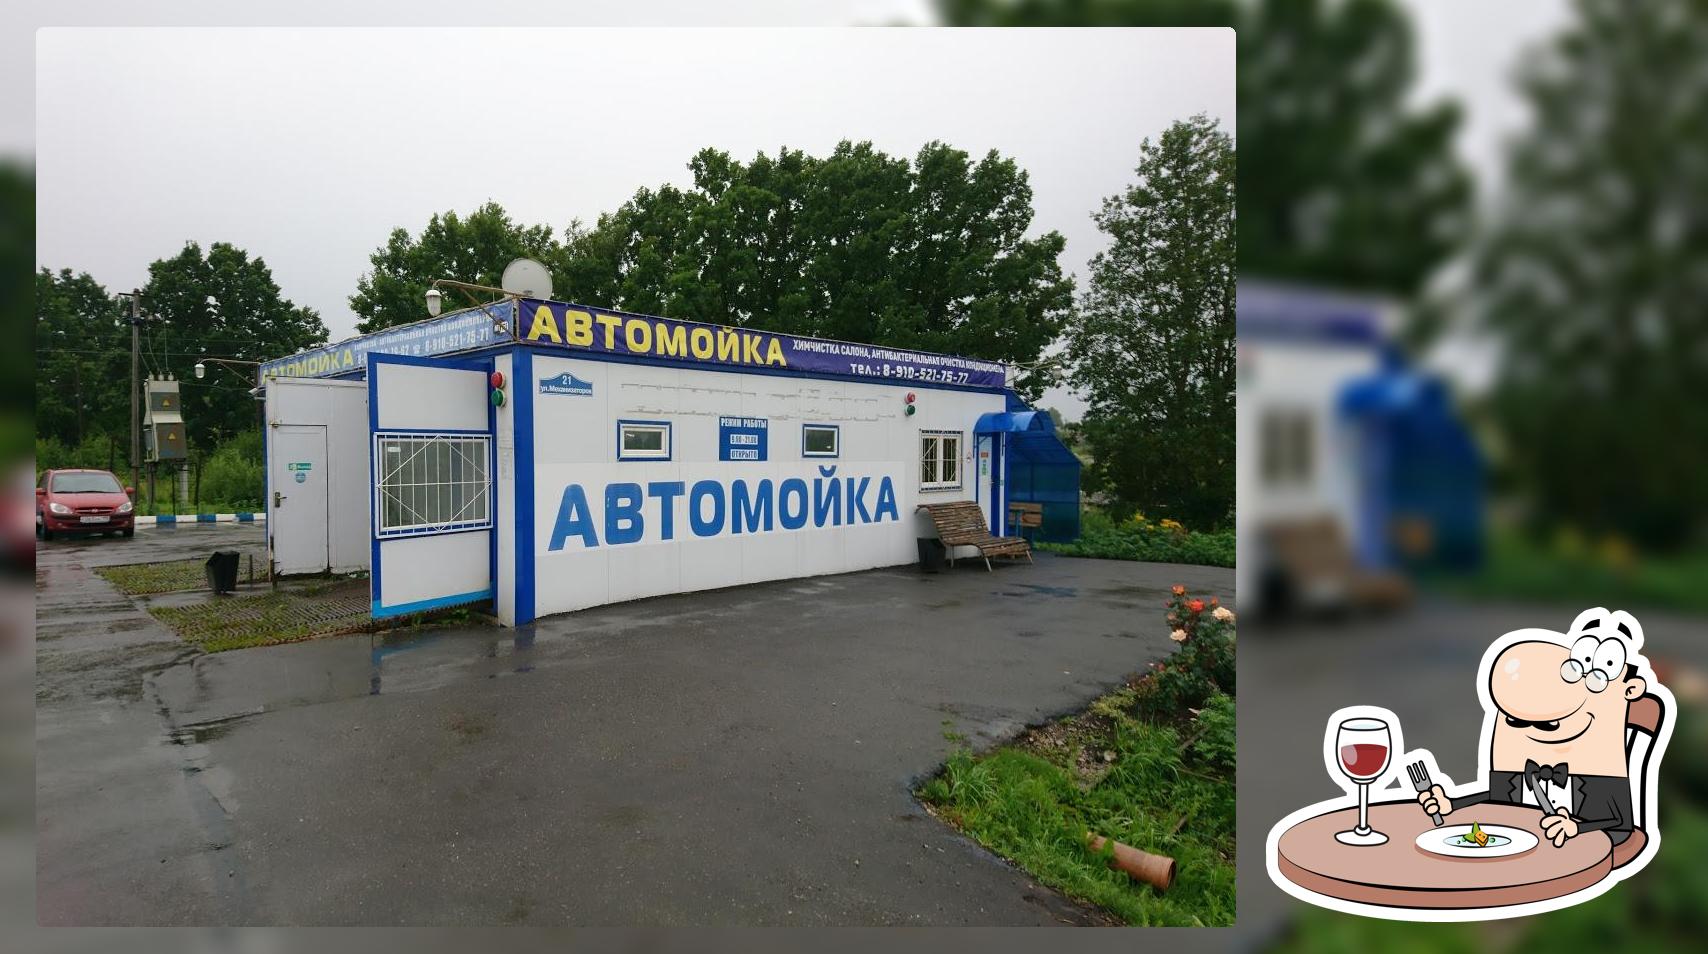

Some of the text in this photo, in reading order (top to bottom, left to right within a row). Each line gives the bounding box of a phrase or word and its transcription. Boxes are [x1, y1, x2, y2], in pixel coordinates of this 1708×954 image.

[527, 305, 787, 367] АВТОМОЙКА
[793, 340, 839, 354] ХИМЧИСТКА
[840, 345, 871, 359] САЛОНА,
[871, 350, 940, 366] АНТИБАКТЕРИАЛЬНАЯ
[941, 358, 966, 368] ОЧИСТКА
[562, 375, 572, 385] 21
[850, 363, 969, 384] тел.: 8-910-521-75-77
[720, 418, 767, 429] РЕЖИМ РАБОТЫ
[731, 450, 757, 459] ОТКРЫТО
[547, 464, 900, 552] АВТОМОЙКА
